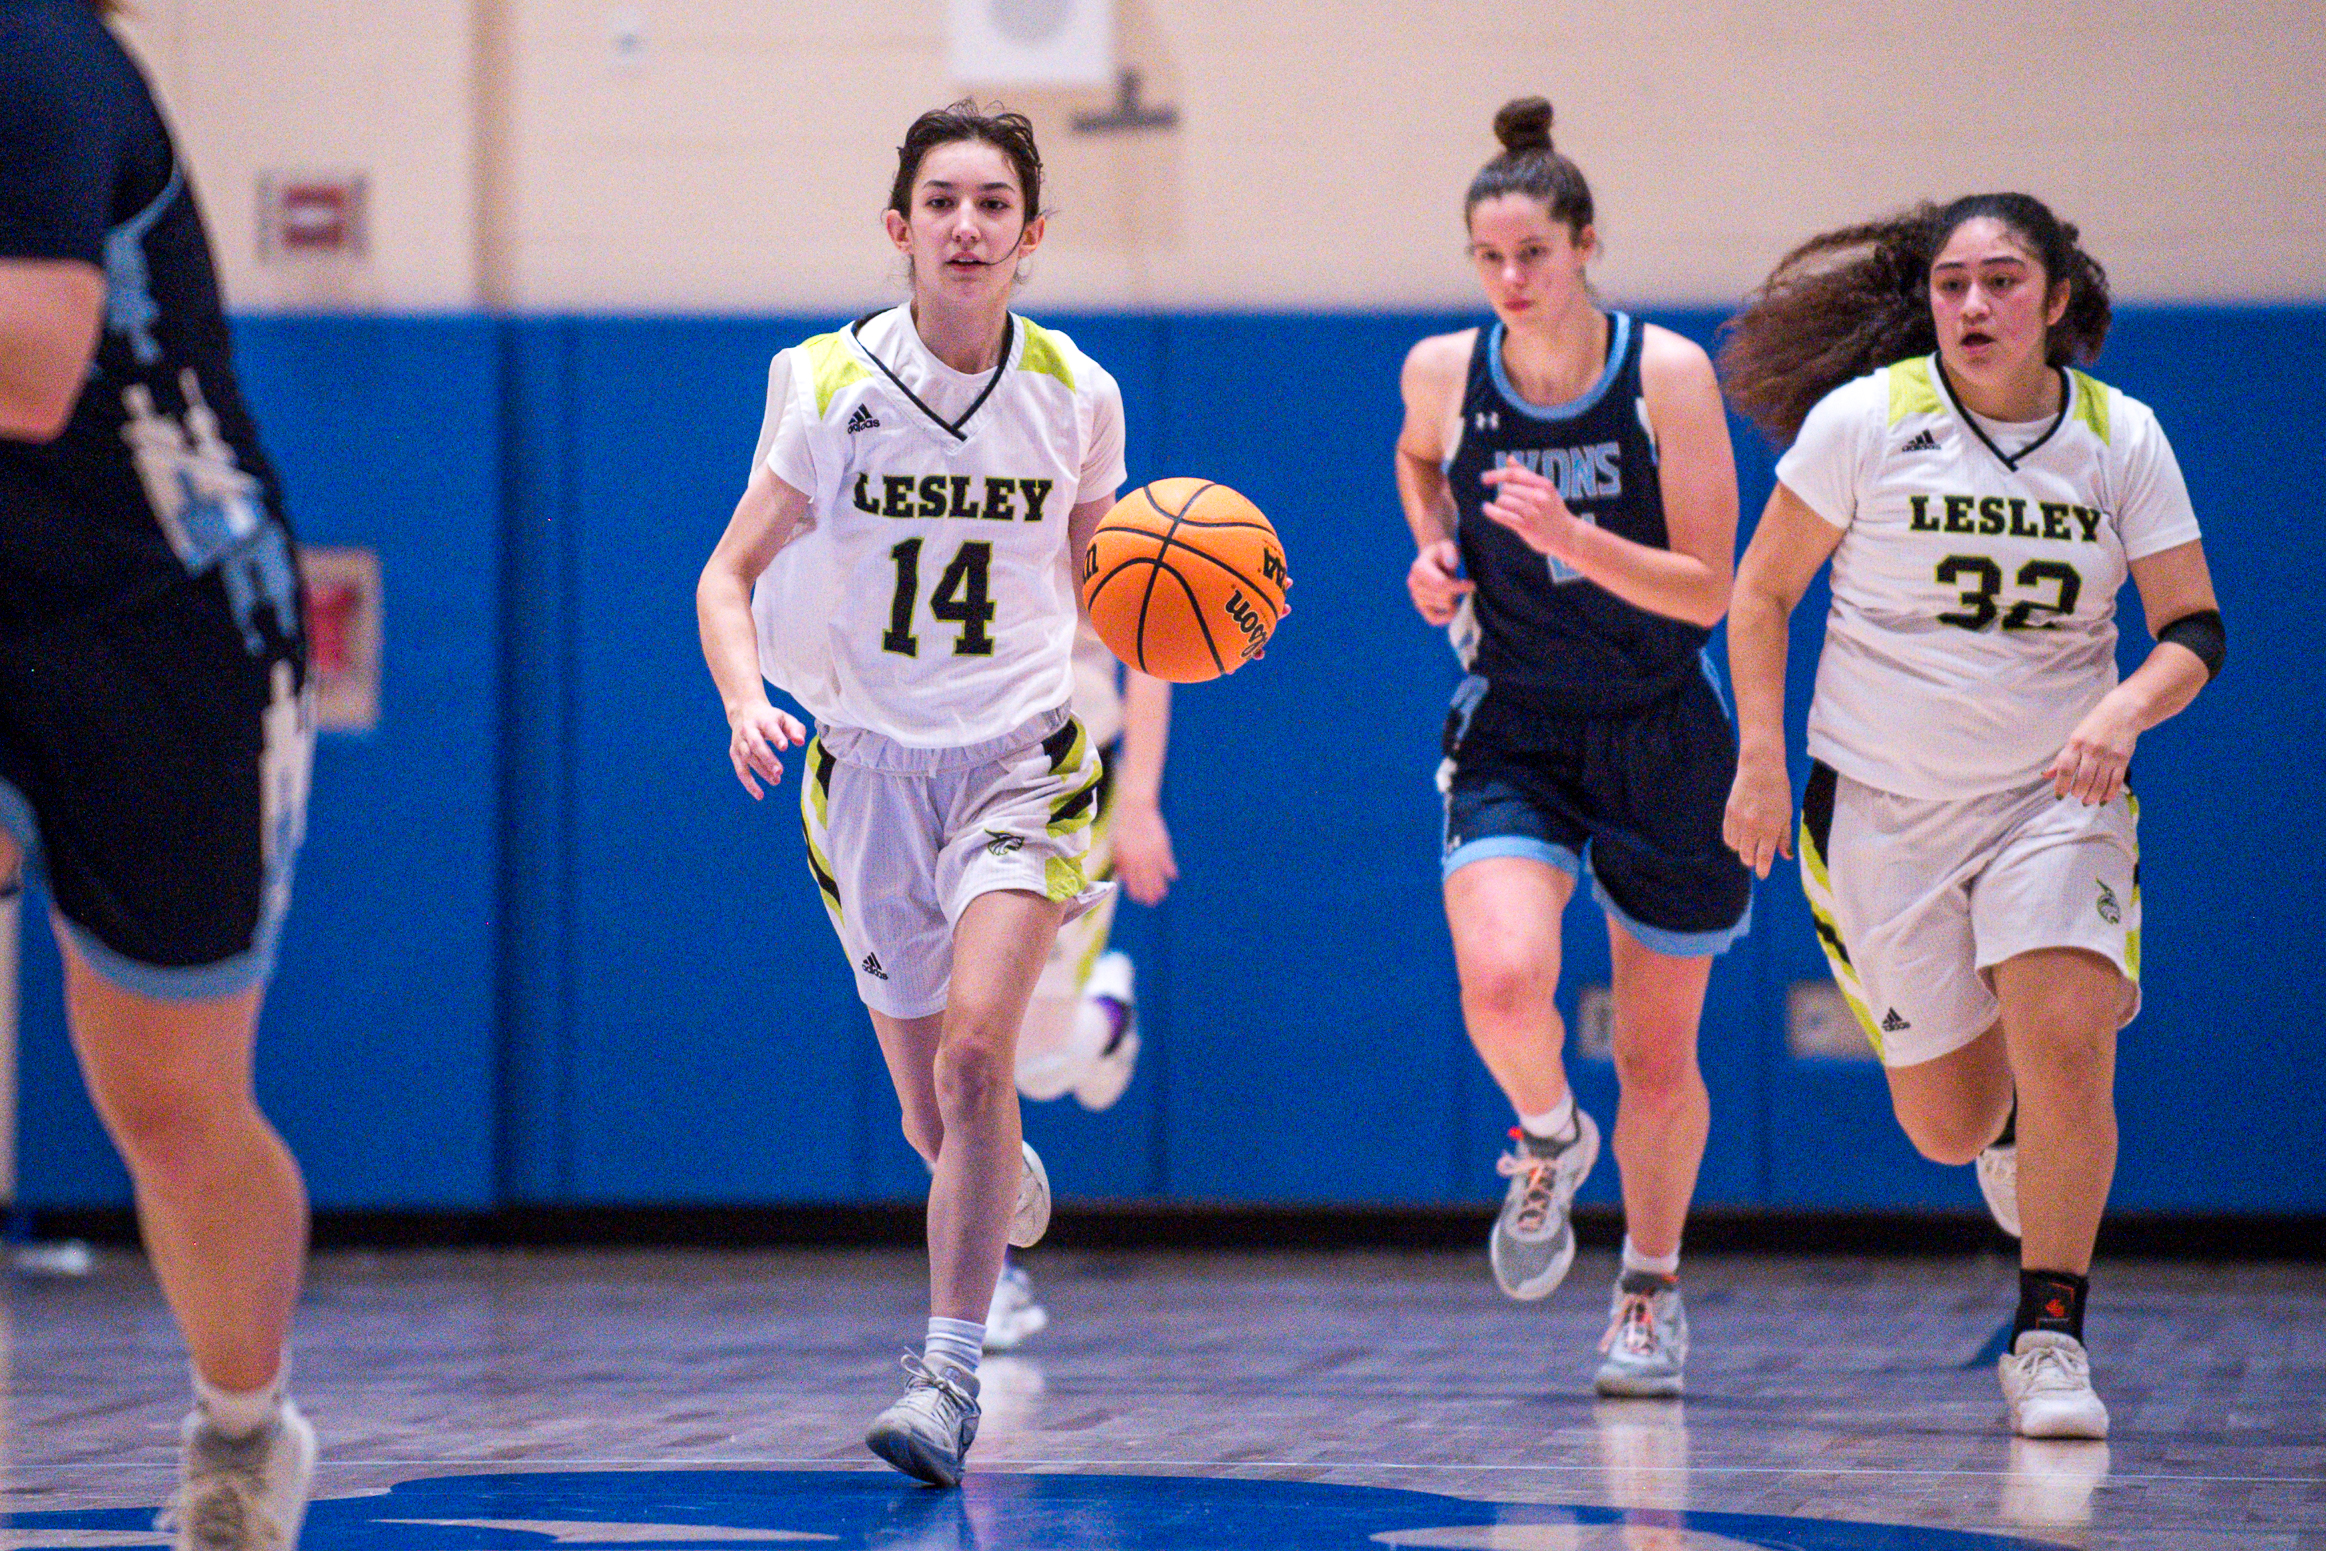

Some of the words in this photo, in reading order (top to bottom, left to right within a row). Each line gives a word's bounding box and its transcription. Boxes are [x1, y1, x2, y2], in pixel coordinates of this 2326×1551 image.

[847, 415, 880, 435] adidas
[852, 472, 1054, 523] LESLEY
[1909, 494, 2101, 543] LESLEY
[881, 536, 998, 658] 14
[1935, 553, 2082, 632] 32
